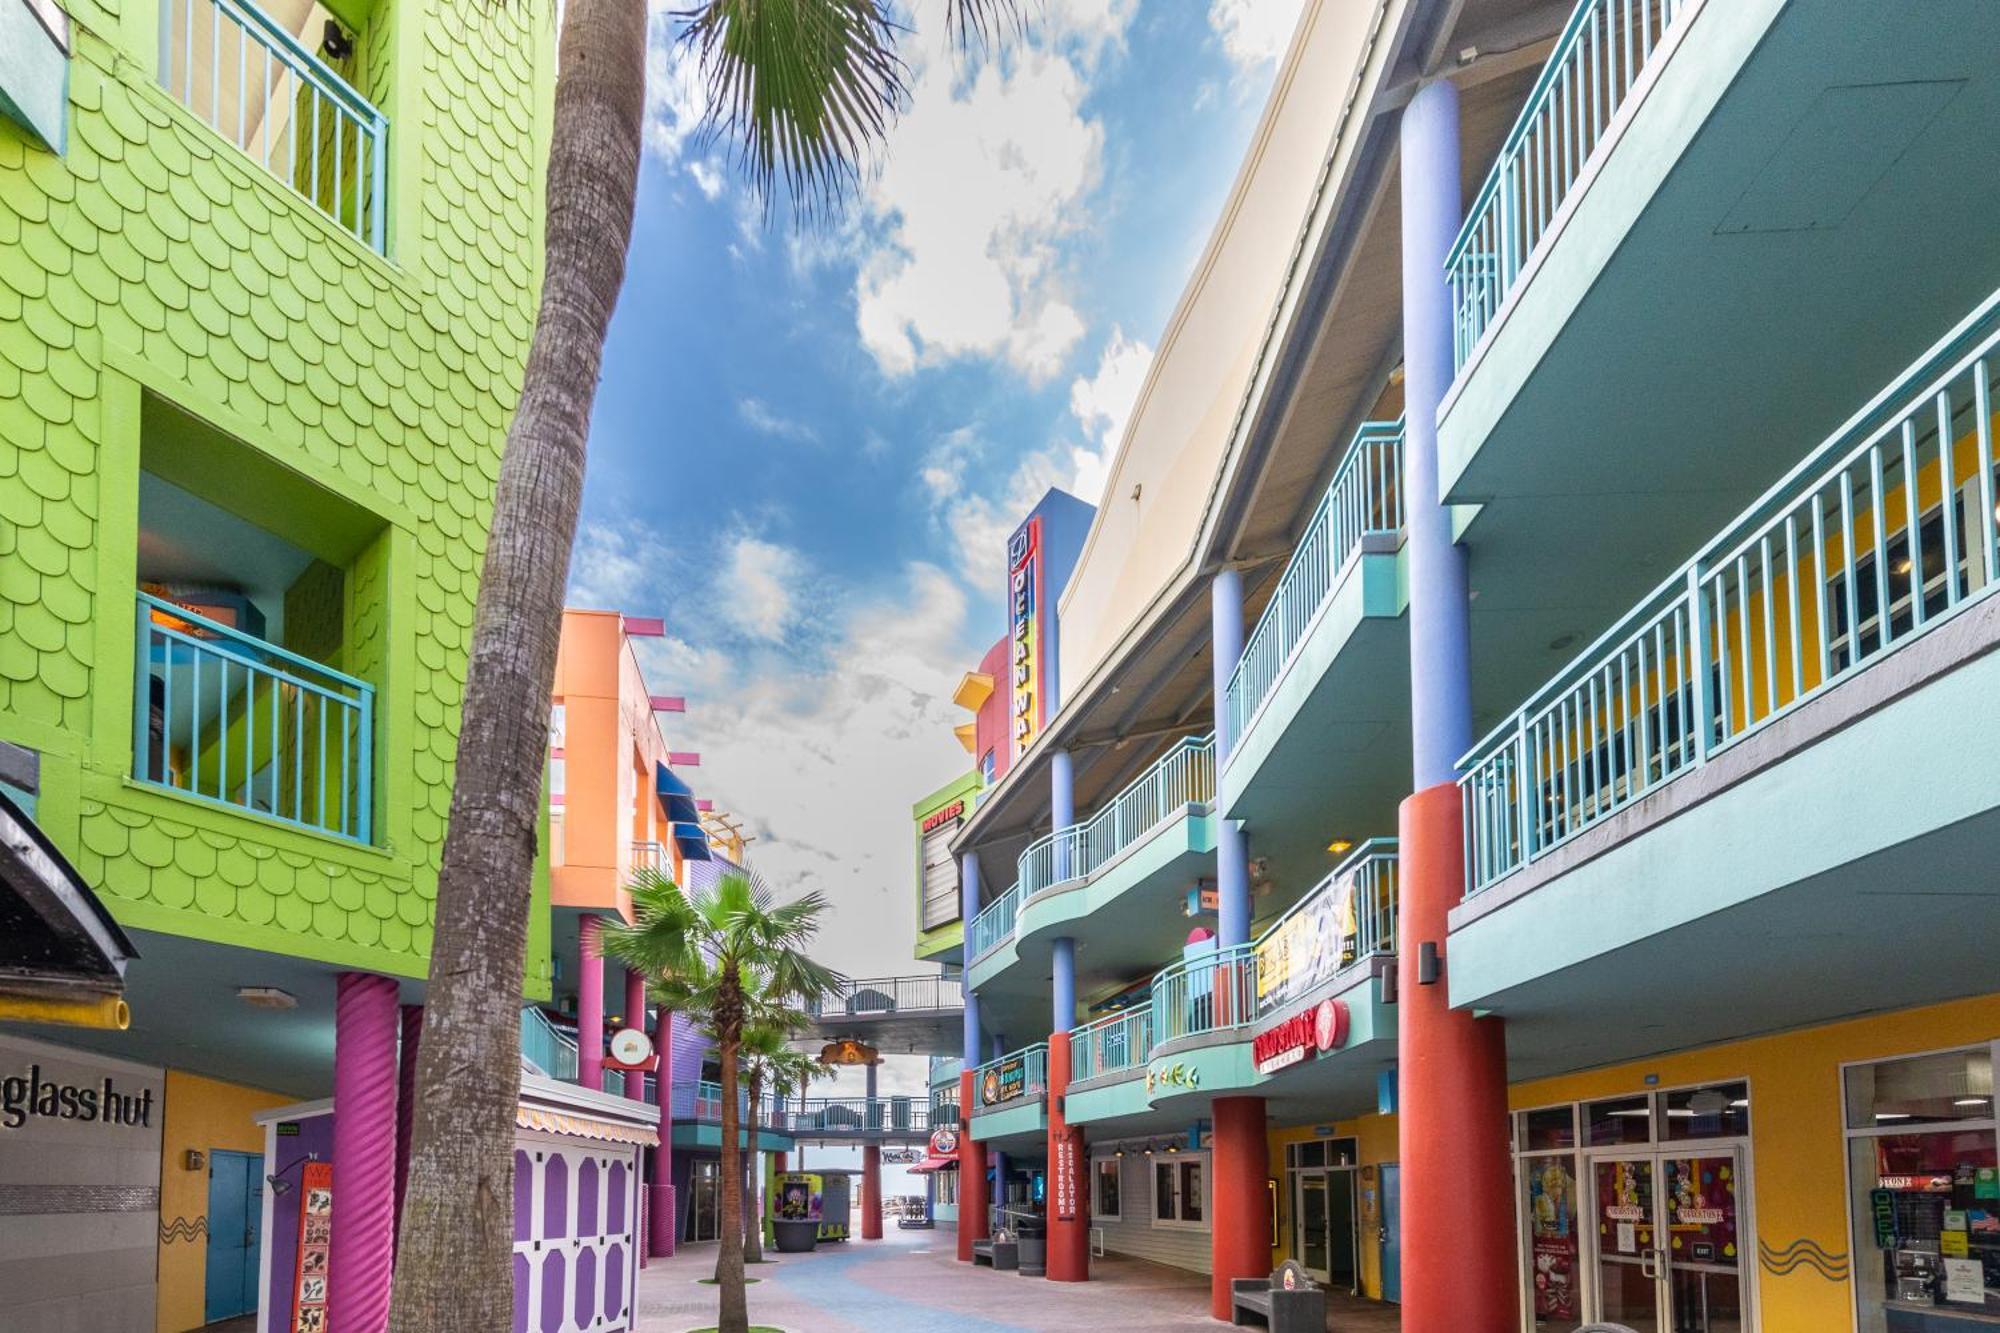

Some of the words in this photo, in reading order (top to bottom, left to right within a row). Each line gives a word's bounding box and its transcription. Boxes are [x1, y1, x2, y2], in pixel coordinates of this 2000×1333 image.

[1013, 572, 1030, 688] OCEAN
[922, 799, 964, 833] MOVIES
[103, 1078, 153, 1128] hut
[1067, 1143, 1075, 1214] ESCALATOR
[1874, 1192, 1893, 1247] OPEN
[1696, 1247, 1711, 1255] EXIT
